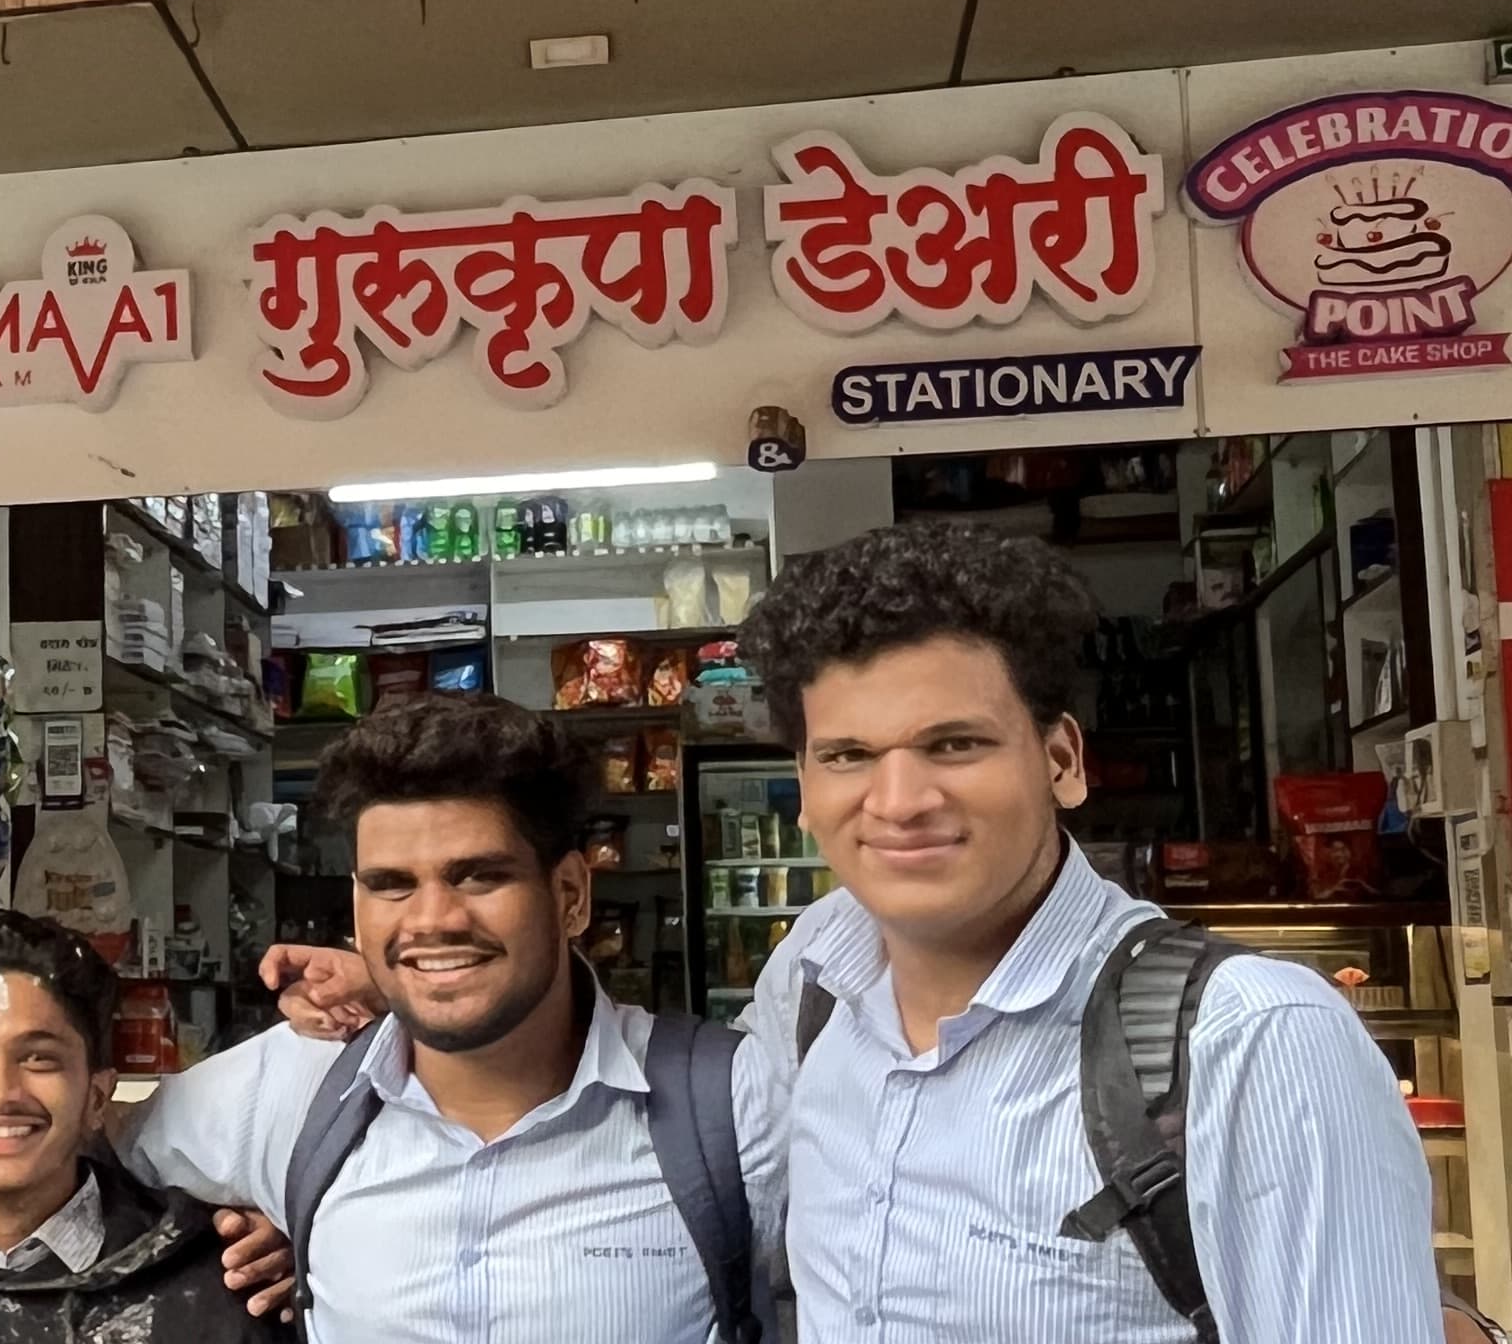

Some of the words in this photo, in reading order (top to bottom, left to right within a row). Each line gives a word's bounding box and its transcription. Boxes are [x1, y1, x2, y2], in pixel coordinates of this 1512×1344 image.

[779, 127, 1147, 312] डेअरी
[68, 258, 107, 277] KING
[1314, 285, 1468, 336] POINT
[1308, 350, 1352, 370] THE
[1358, 345, 1420, 366] CAKE
[1427, 341, 1492, 362] SHOP
[841, 355, 1188, 416] STATIONARY
[757, 441, 792, 468] &
